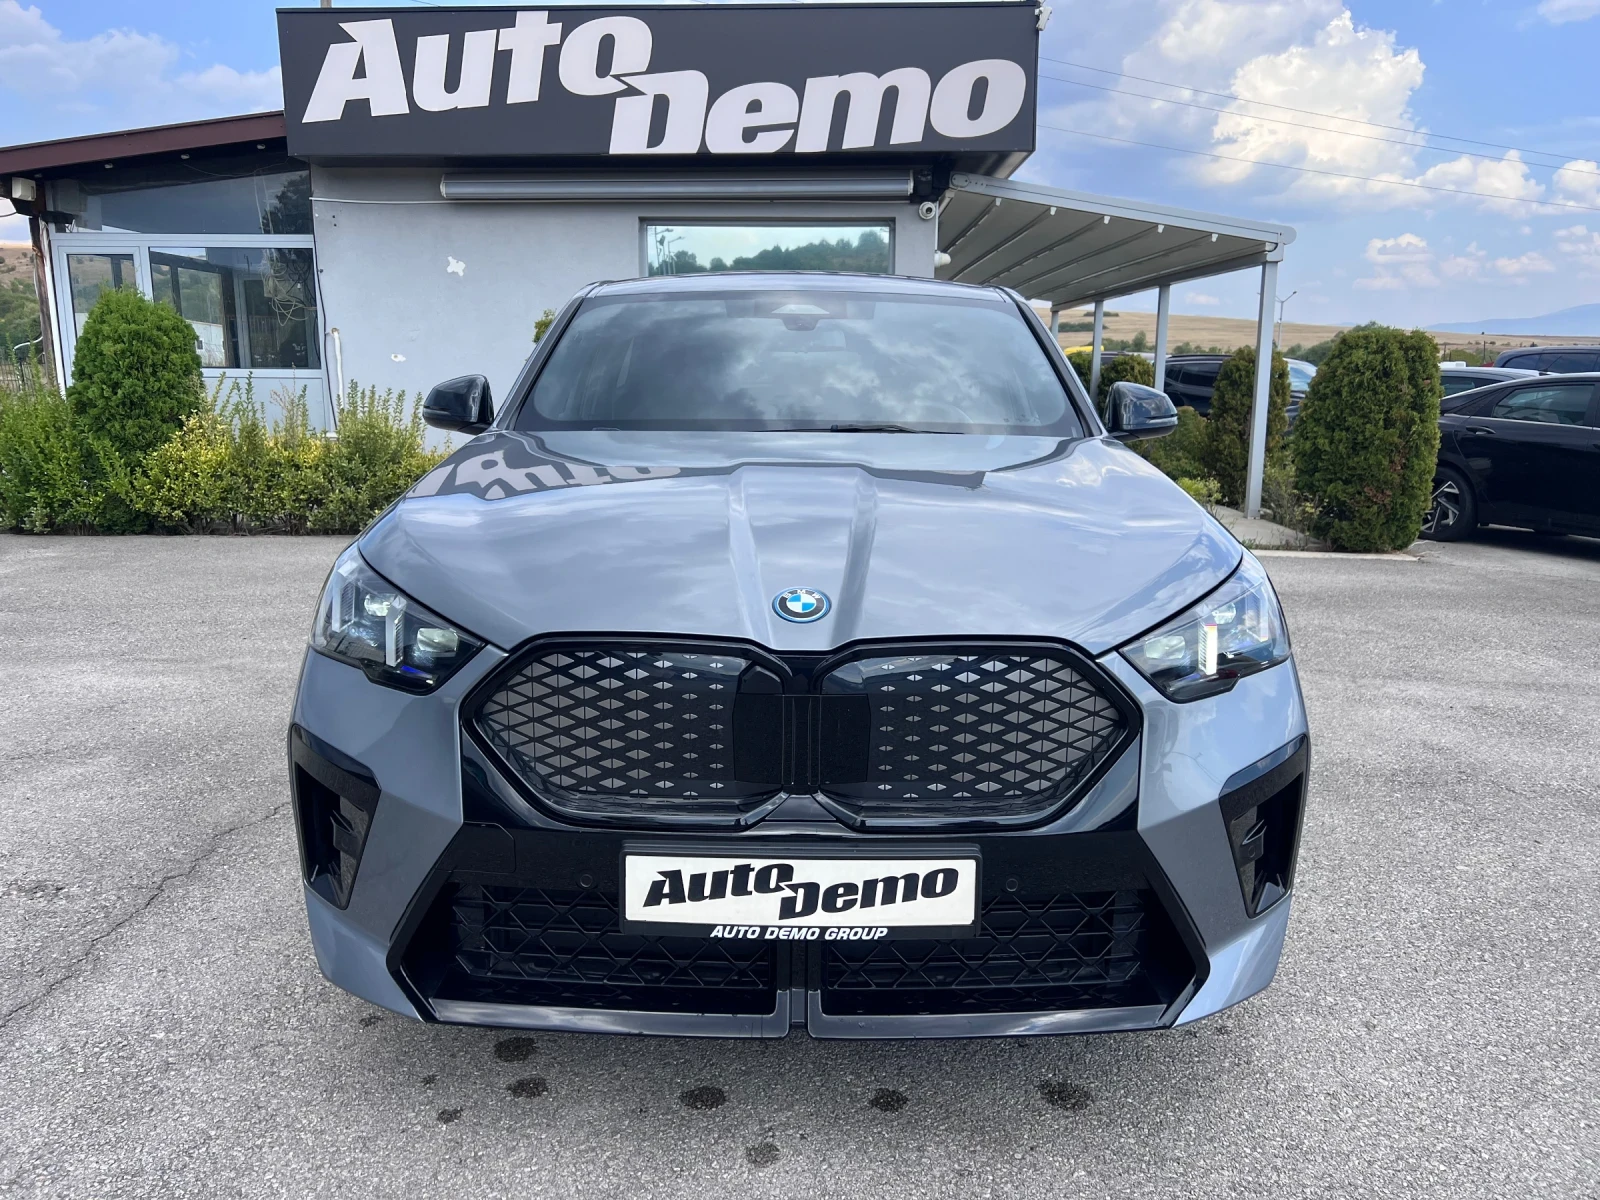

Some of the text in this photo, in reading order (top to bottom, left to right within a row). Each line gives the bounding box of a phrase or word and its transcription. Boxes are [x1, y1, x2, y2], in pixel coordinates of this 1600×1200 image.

[303, 11, 1027, 155] Auto Demo
[643, 863, 959, 920] Auto Demo
[709, 925, 888, 940] AUTO DEMO GROUP
